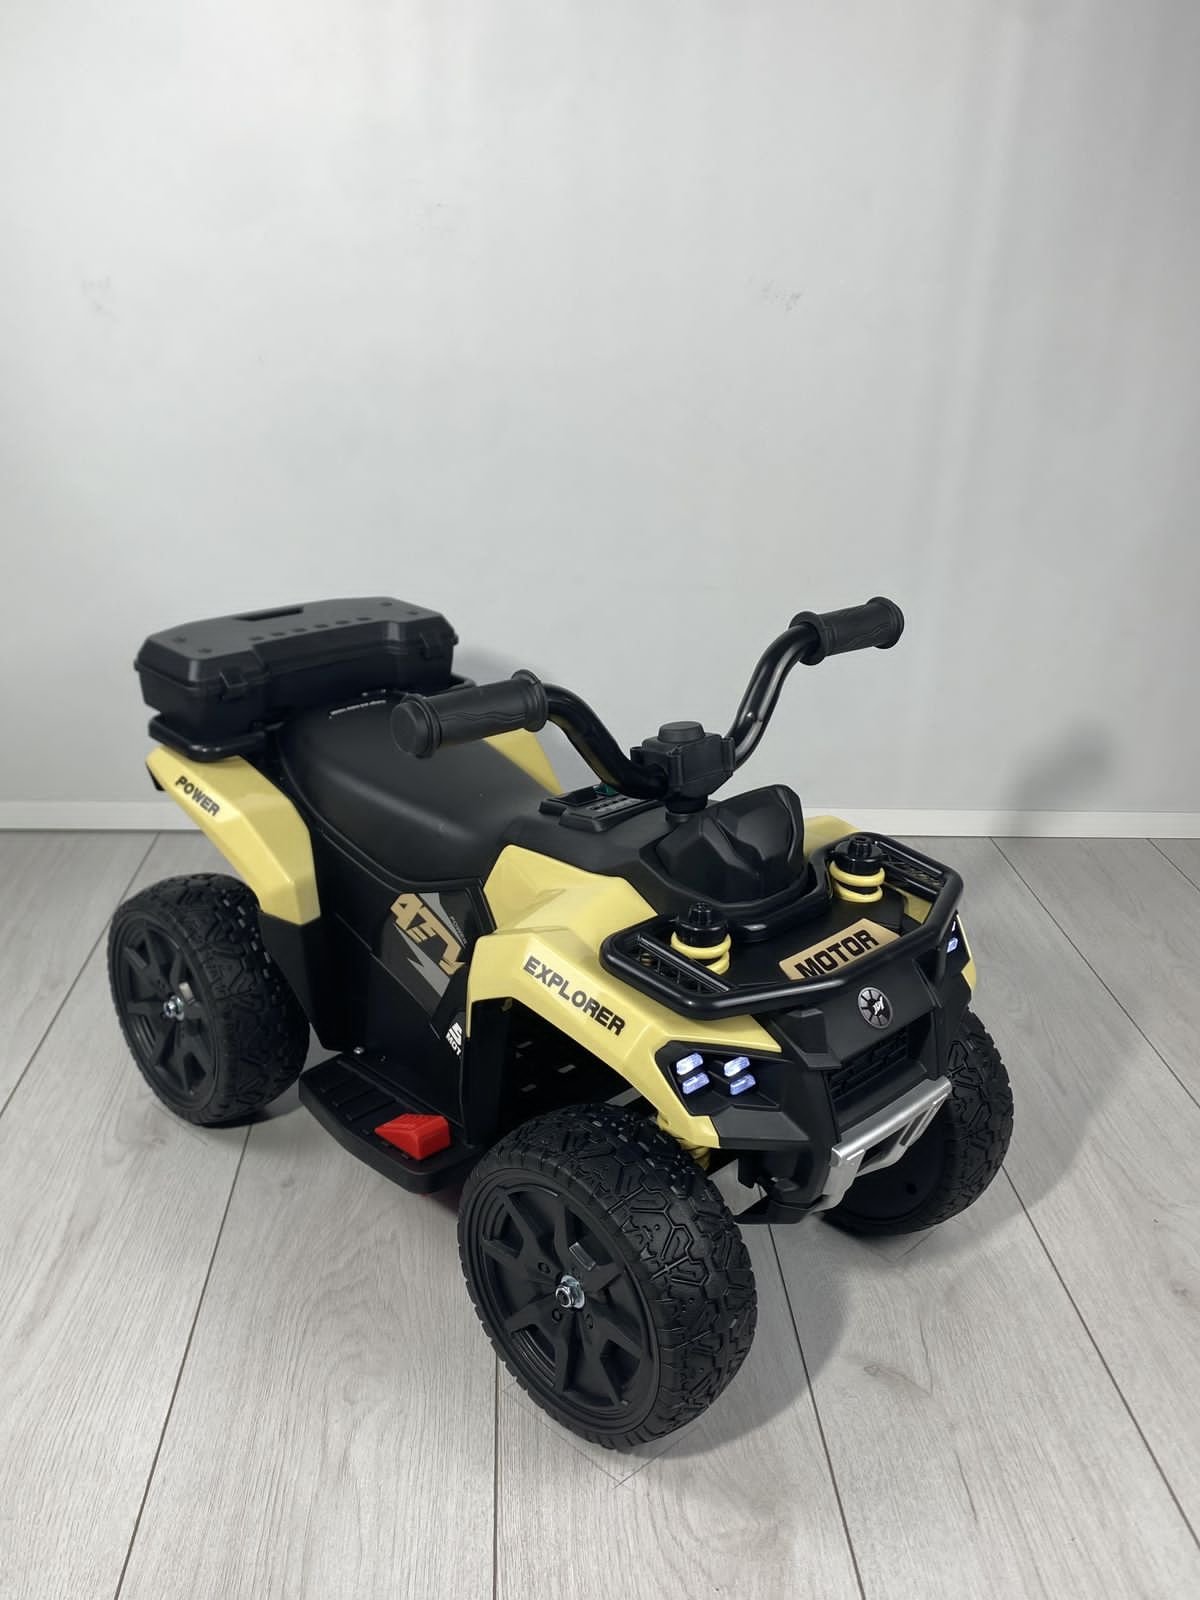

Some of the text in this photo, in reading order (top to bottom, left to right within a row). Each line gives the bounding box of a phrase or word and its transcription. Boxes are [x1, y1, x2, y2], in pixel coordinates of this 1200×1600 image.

[175, 775, 220, 816] POWER
[794, 929, 880, 978] MOTOR
[523, 955, 626, 1036] EXPLORER
